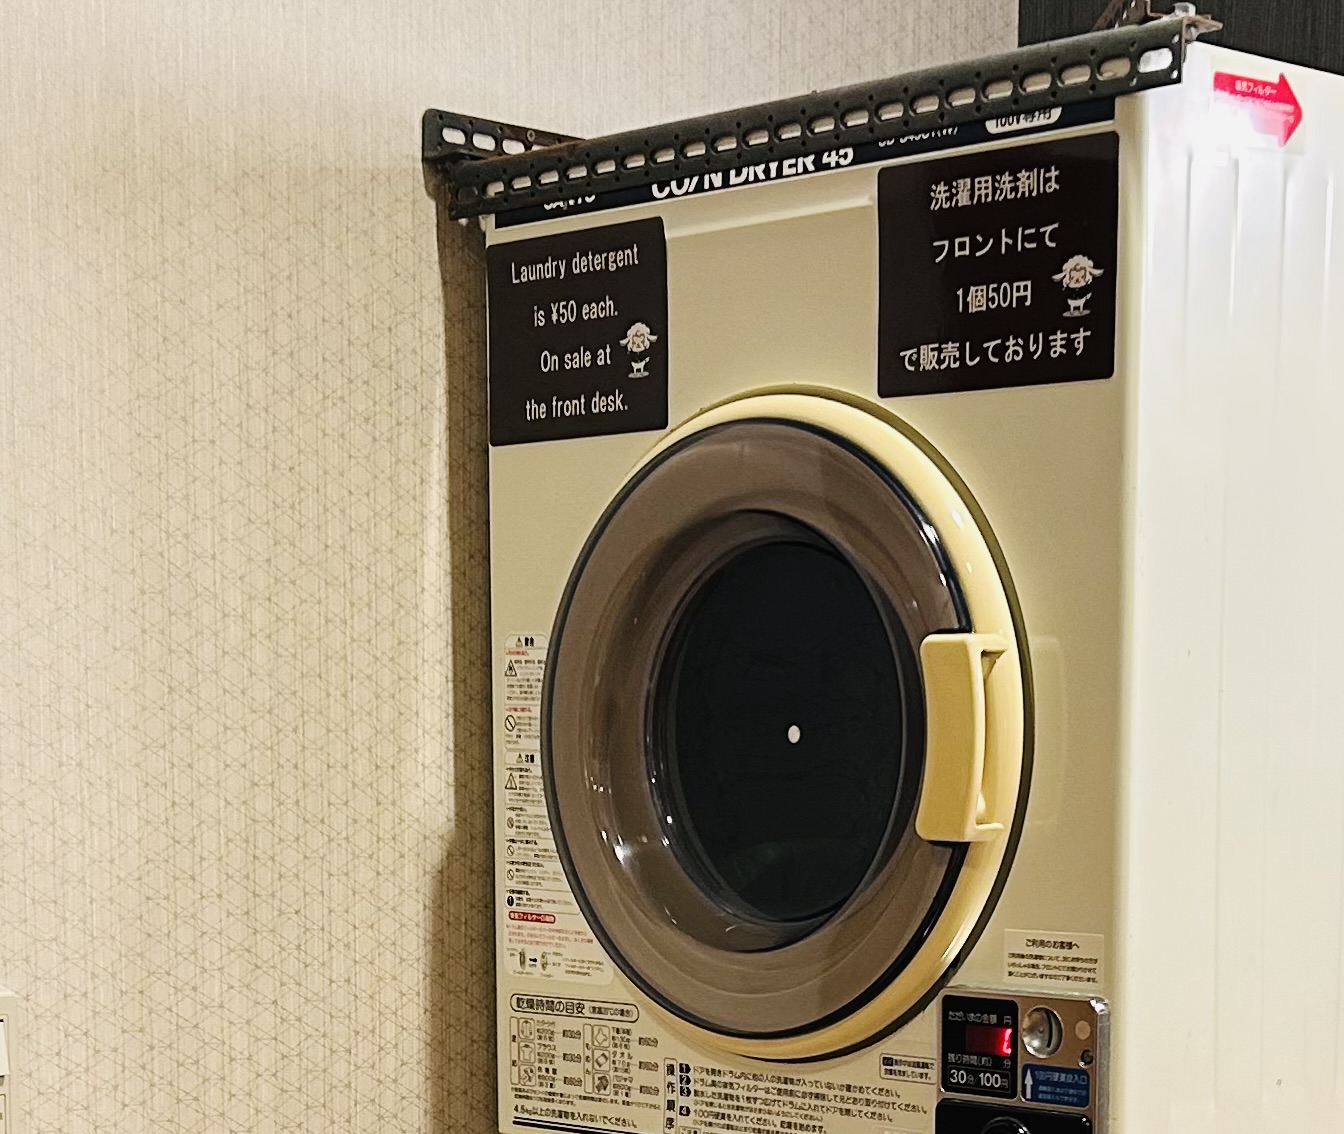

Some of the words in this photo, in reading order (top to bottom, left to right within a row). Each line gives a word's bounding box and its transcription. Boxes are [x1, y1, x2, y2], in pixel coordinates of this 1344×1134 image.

[930, 165, 1061, 211] 洗濯用洗剤は
[932, 222, 1060, 264] フロントにて
[511, 256, 566, 284] Laundry
[571, 243, 639, 274] detergent
[533, 305, 546, 328] is
[551, 300, 577, 325] ¥50
[582, 295, 619, 321] each.
[956, 280, 1032, 314] 1個50円
[540, 350, 558, 373] On
[564, 346, 591, 370] sale
[596, 344, 612, 366] at
[899, 326, 1092, 373] で販売しております
[526, 398, 547, 422] the
[552, 394, 586, 418] front
[591, 388, 629, 414] desk.
